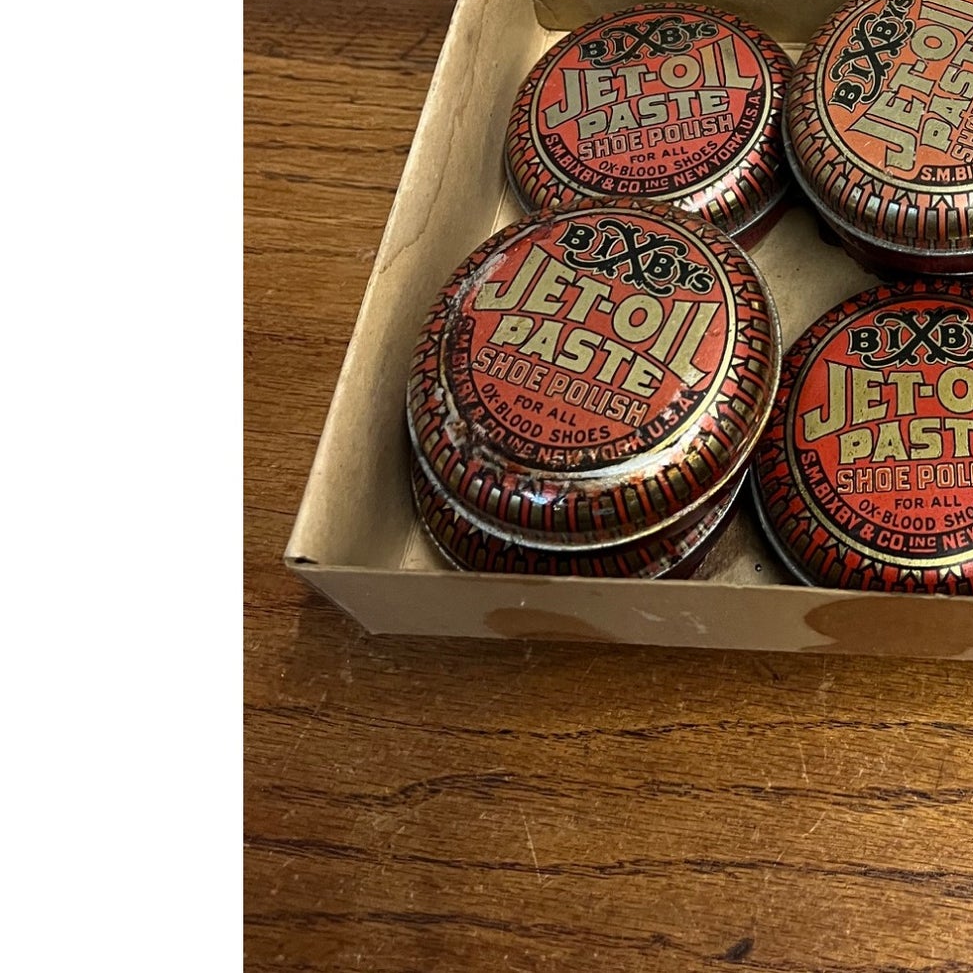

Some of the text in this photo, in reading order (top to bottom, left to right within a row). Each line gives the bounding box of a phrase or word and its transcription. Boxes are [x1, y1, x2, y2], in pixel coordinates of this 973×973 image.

[543, 35, 759, 129] JET-OIL
[577, 90, 730, 140] PASTE
[577, 114, 734, 161] SHOE POLISH
[629, 146, 689, 164] FOR ALL
[599, 140, 718, 178] OX-BLOOD SHOES
[602, 178, 615, 191] &
[673, 162, 710, 187] NEW
[473, 245, 722, 387] JET-OIL
[488, 312, 666, 399] PASTE
[472, 346, 651, 428] SHOE POLISH
[481, 383, 611, 444] OX-BLOOD SHOES
[513, 394, 578, 427] FOR ALL
[836, 465, 911, 494] SHOE
[858, 499, 936, 531] OX-BLOOD
[894, 494, 962, 510] FOR ALL
[859, 524, 874, 540] &
